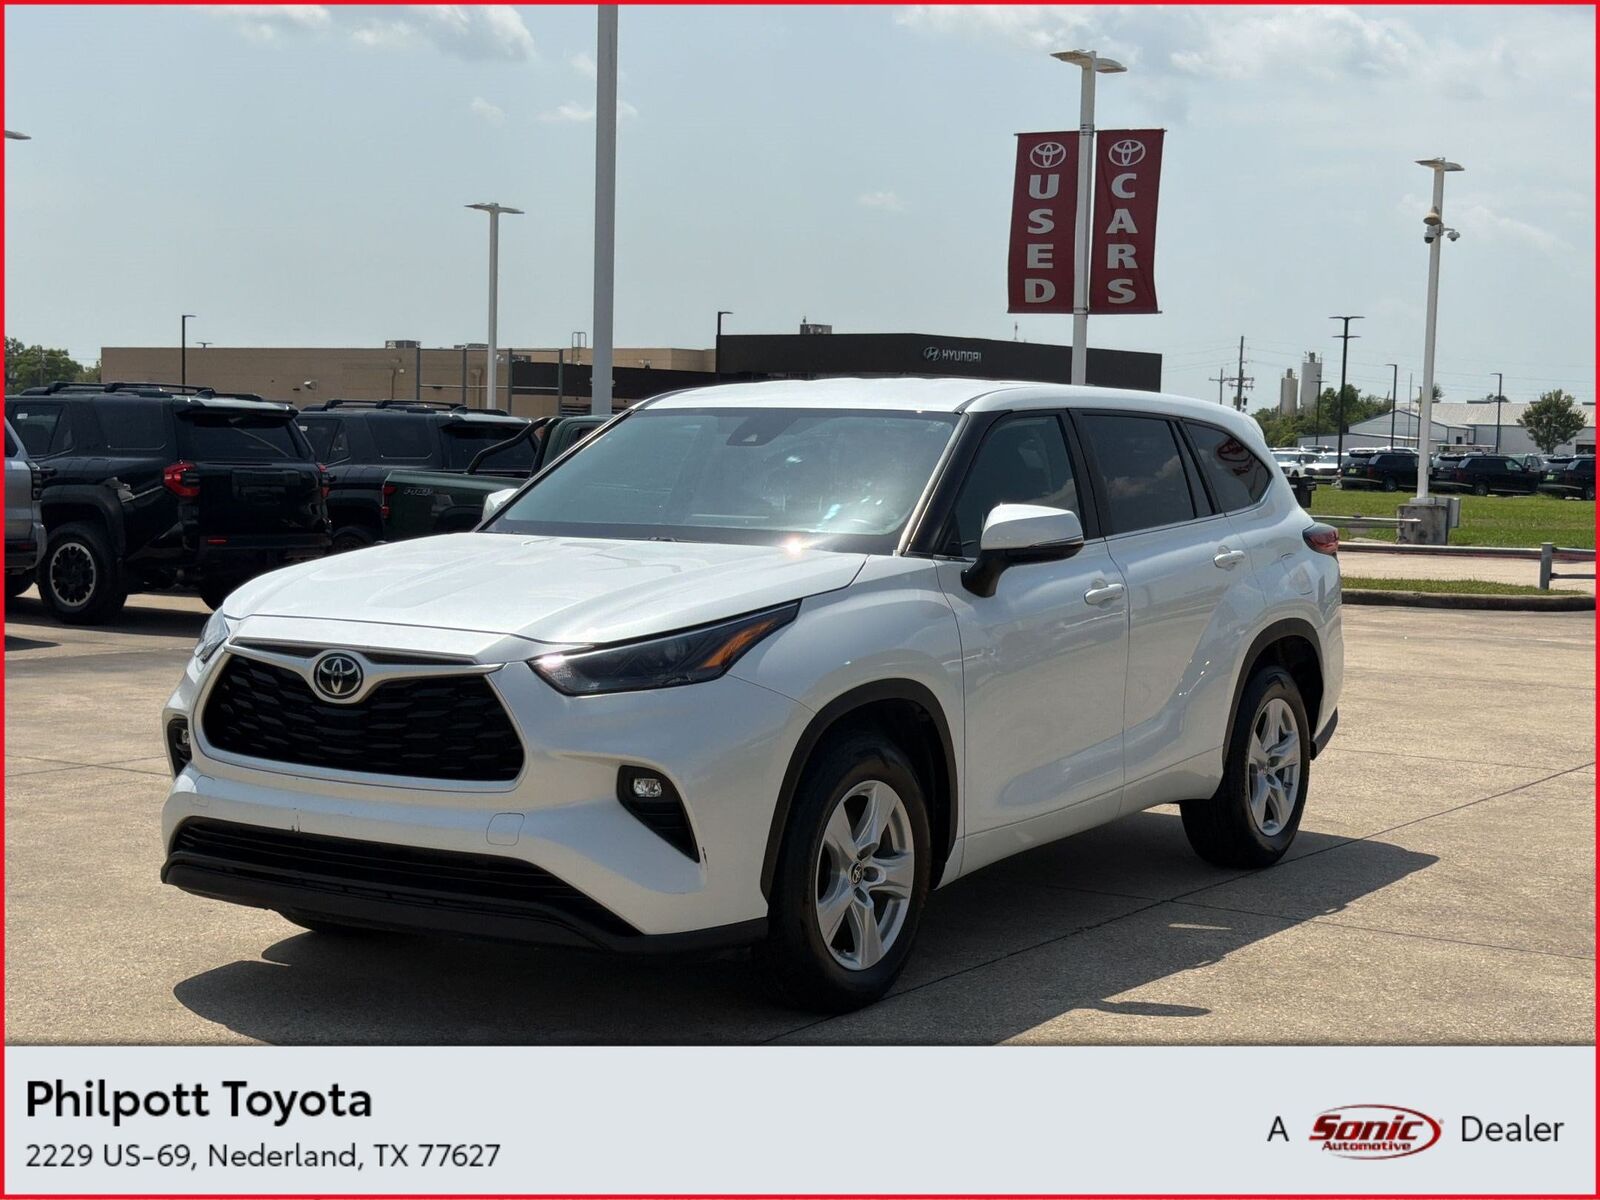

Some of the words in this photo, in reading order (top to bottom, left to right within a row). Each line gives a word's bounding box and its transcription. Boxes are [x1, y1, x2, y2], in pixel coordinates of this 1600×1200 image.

[1024, 174, 1060, 303] USED
[1105, 173, 1138, 304] CARS
[942, 349, 982, 362] HYUNDAI
